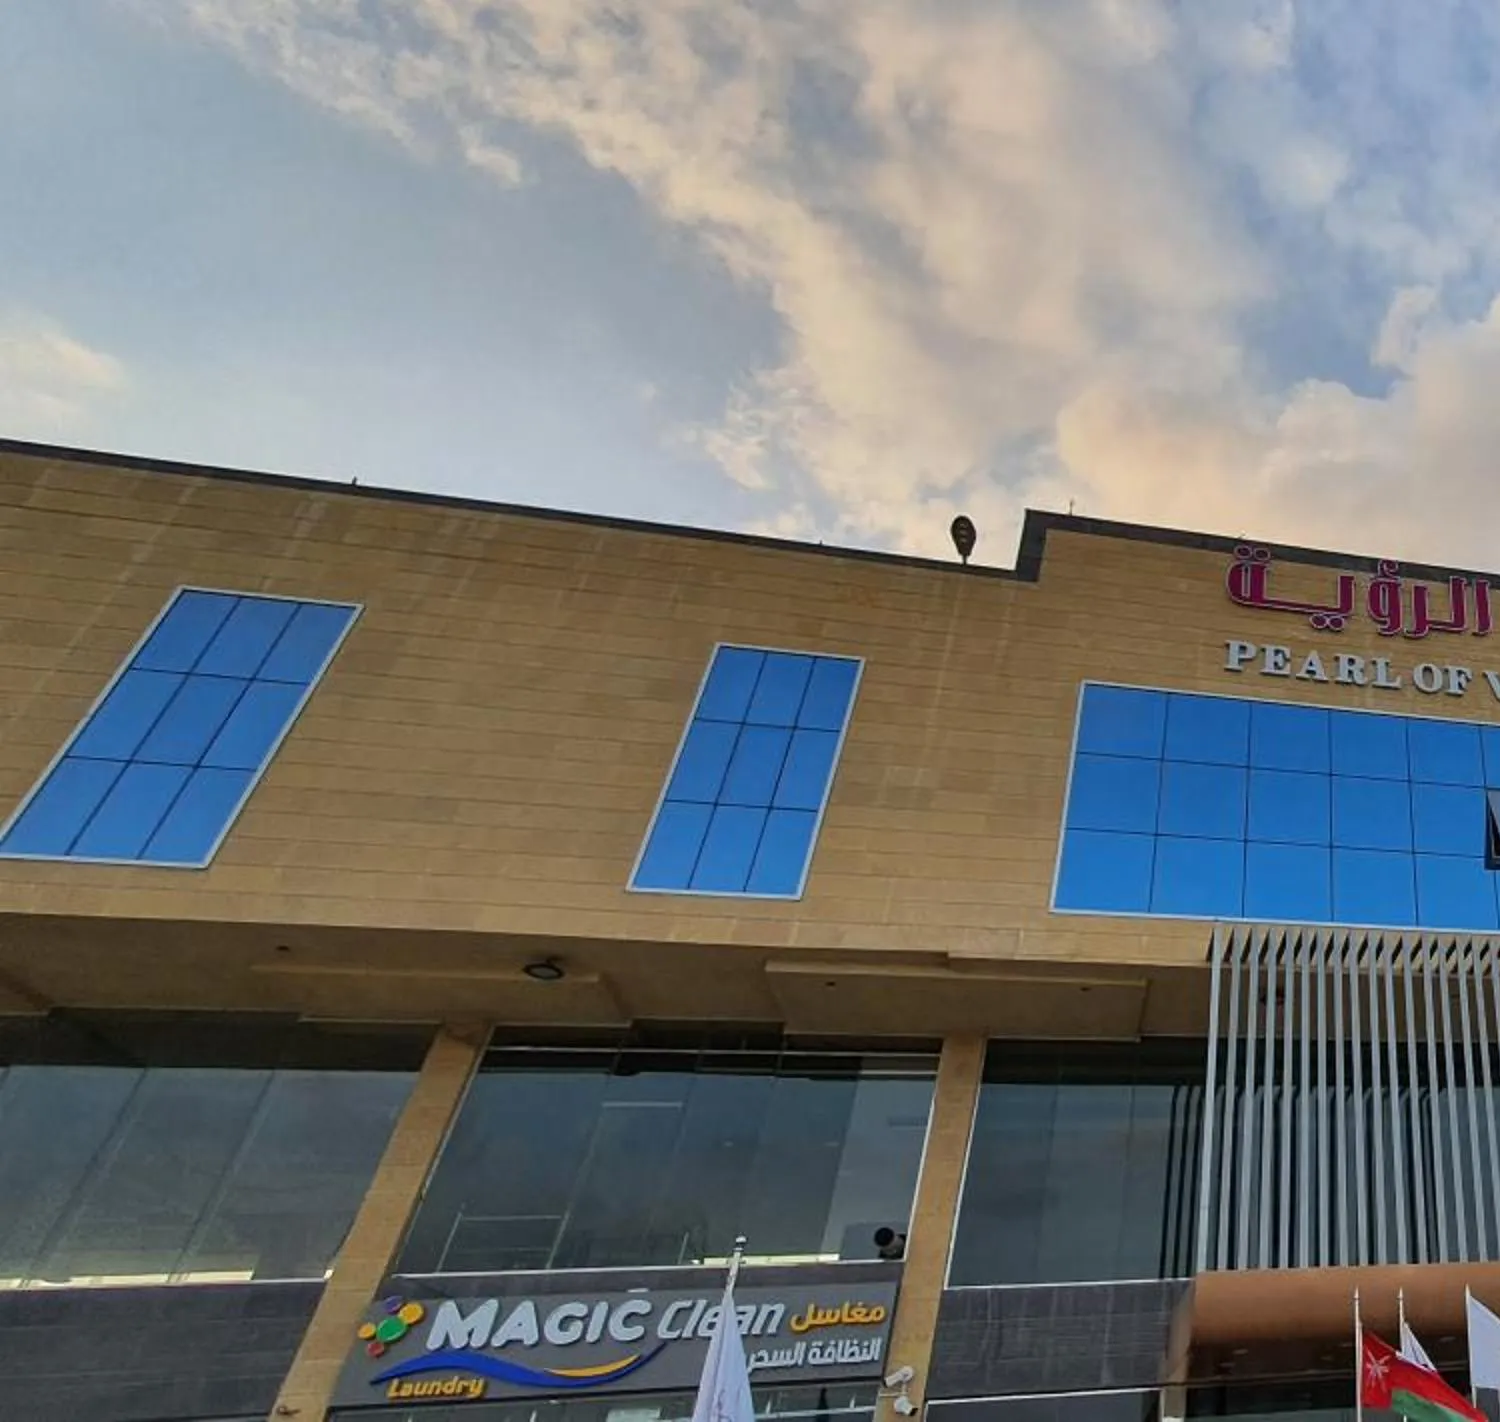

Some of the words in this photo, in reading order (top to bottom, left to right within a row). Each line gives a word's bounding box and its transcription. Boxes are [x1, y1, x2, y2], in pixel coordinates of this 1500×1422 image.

[1226, 545, 1493, 639] الرؤية
[1224, 639, 1401, 690] PEARL
[1412, 662, 1474, 697] OF
[425, 1299, 652, 1350] MAGIC
[790, 1301, 887, 1334] مغاسل
[746, 1339, 805, 1374] السحر
[808, 1337, 883, 1367] النظافة
[387, 1375, 487, 1398] Laundry
